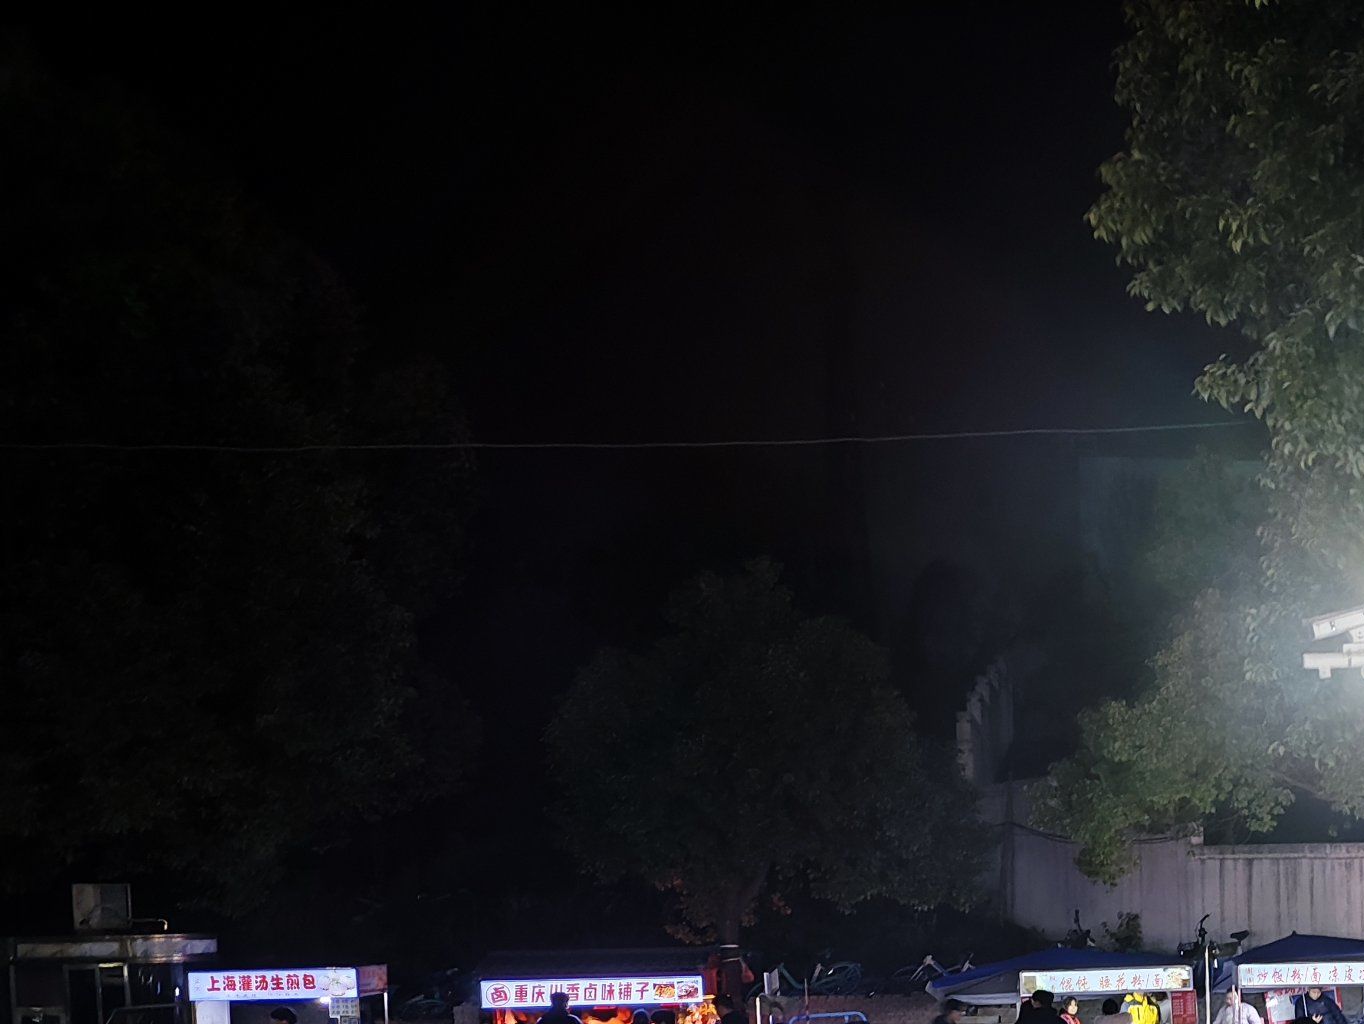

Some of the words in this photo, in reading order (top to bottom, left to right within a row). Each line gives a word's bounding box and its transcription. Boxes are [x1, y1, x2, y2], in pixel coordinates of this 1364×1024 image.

[207, 974, 316, 992] 上海灌汤生煎包
[514, 982, 650, 1003] 重庆川香卤味铺子
